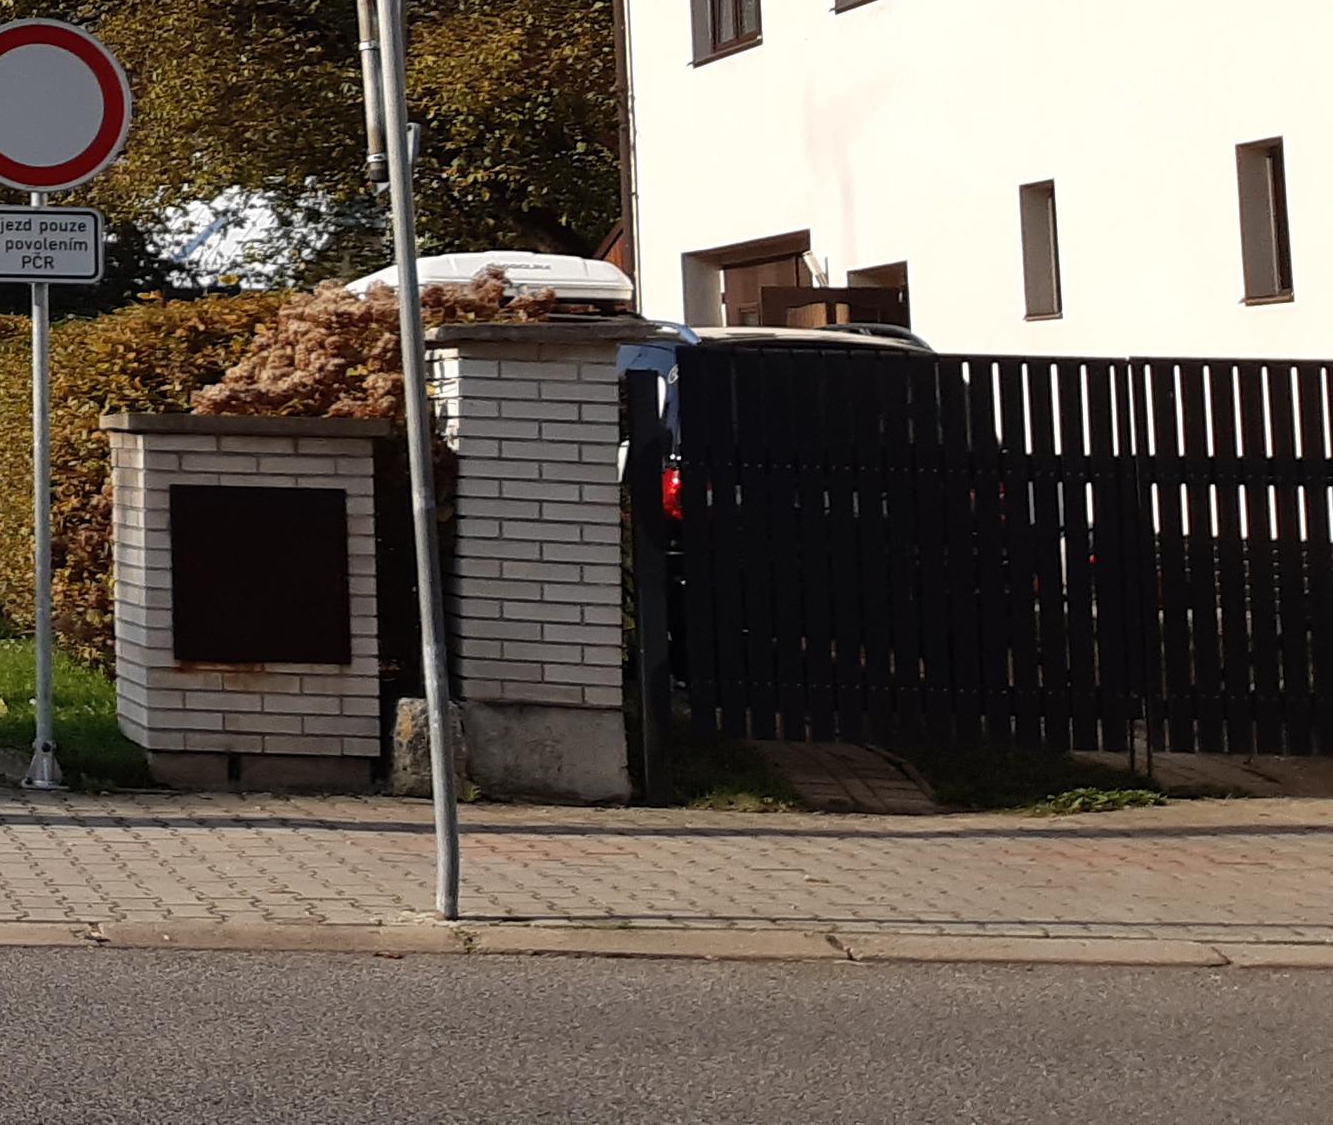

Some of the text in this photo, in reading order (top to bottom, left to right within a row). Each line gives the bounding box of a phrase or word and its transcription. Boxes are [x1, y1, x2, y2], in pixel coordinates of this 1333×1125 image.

[39, 221, 87, 235] pouze
[5, 237, 88, 253] povolením
[21, 251, 55, 270] PČR
